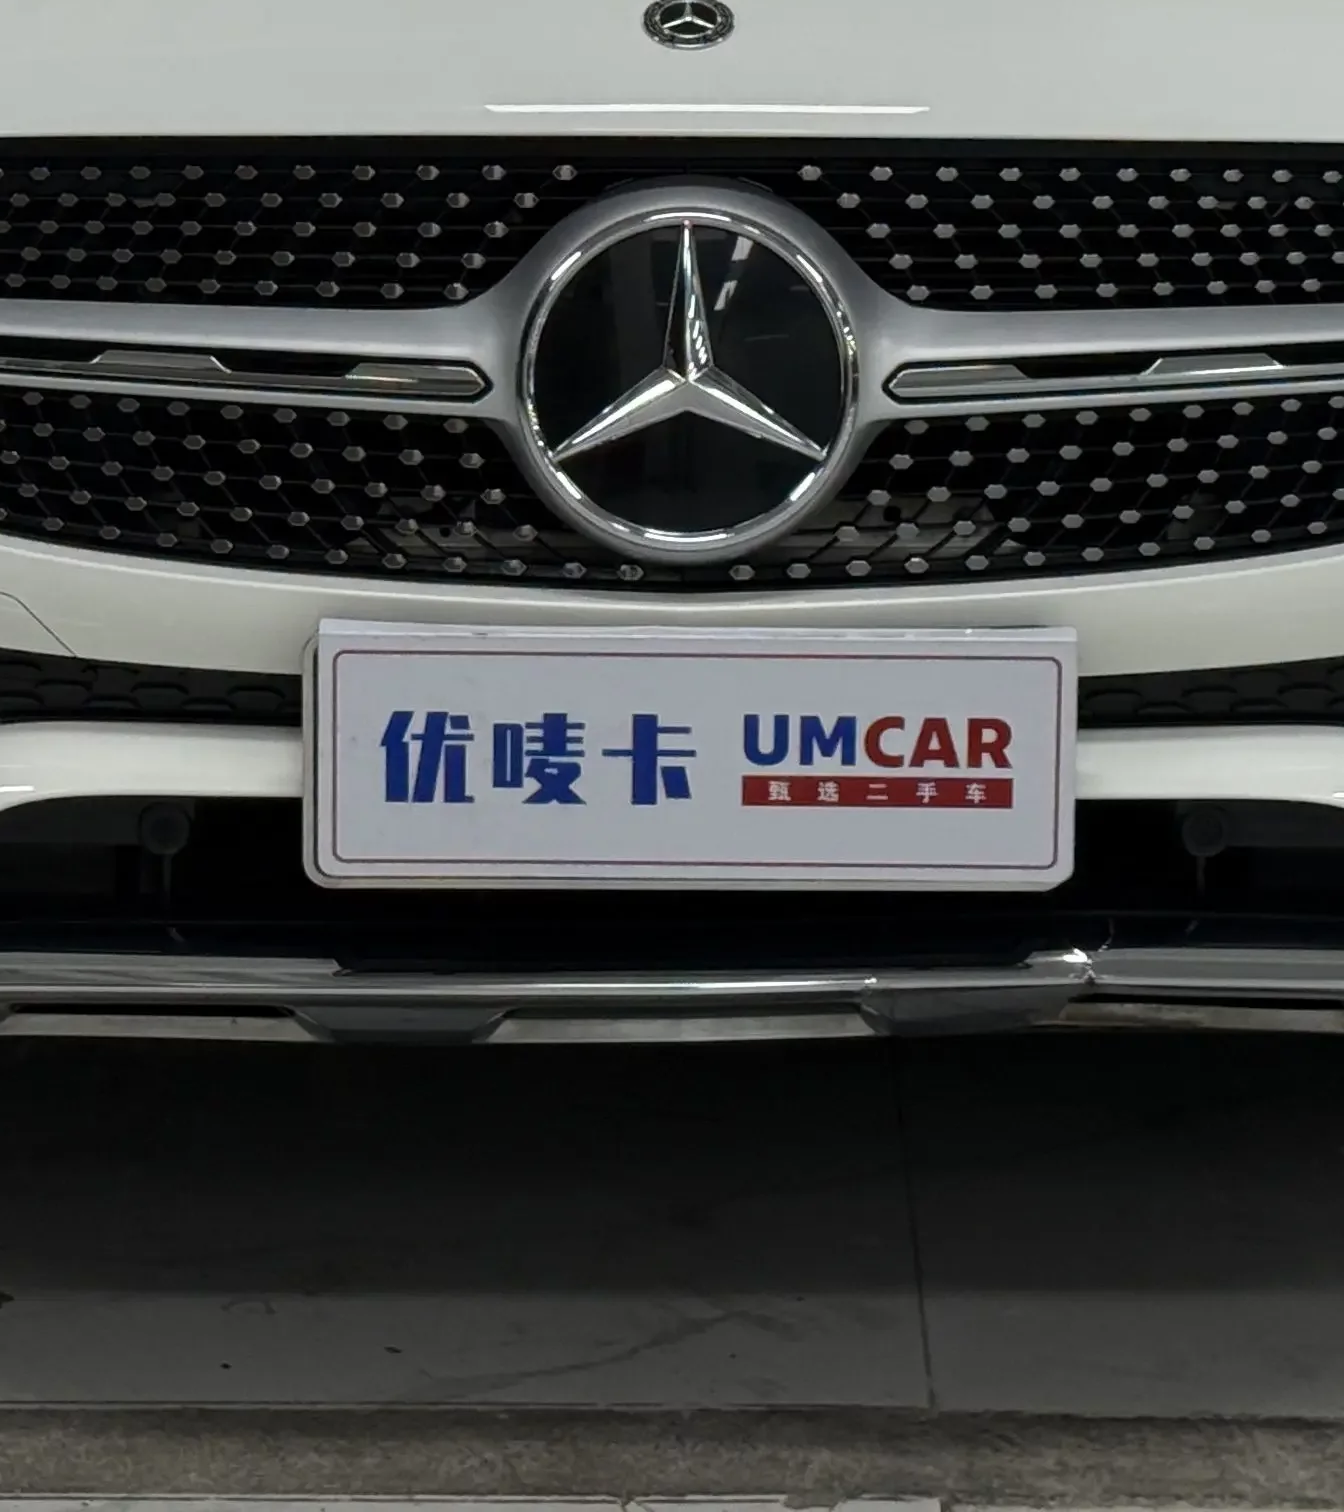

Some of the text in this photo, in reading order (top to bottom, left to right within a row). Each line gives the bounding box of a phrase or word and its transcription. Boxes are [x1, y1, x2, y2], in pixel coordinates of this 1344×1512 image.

[380, 710, 696, 806] 优唛卡
[742, 713, 1013, 769] UMCAR
